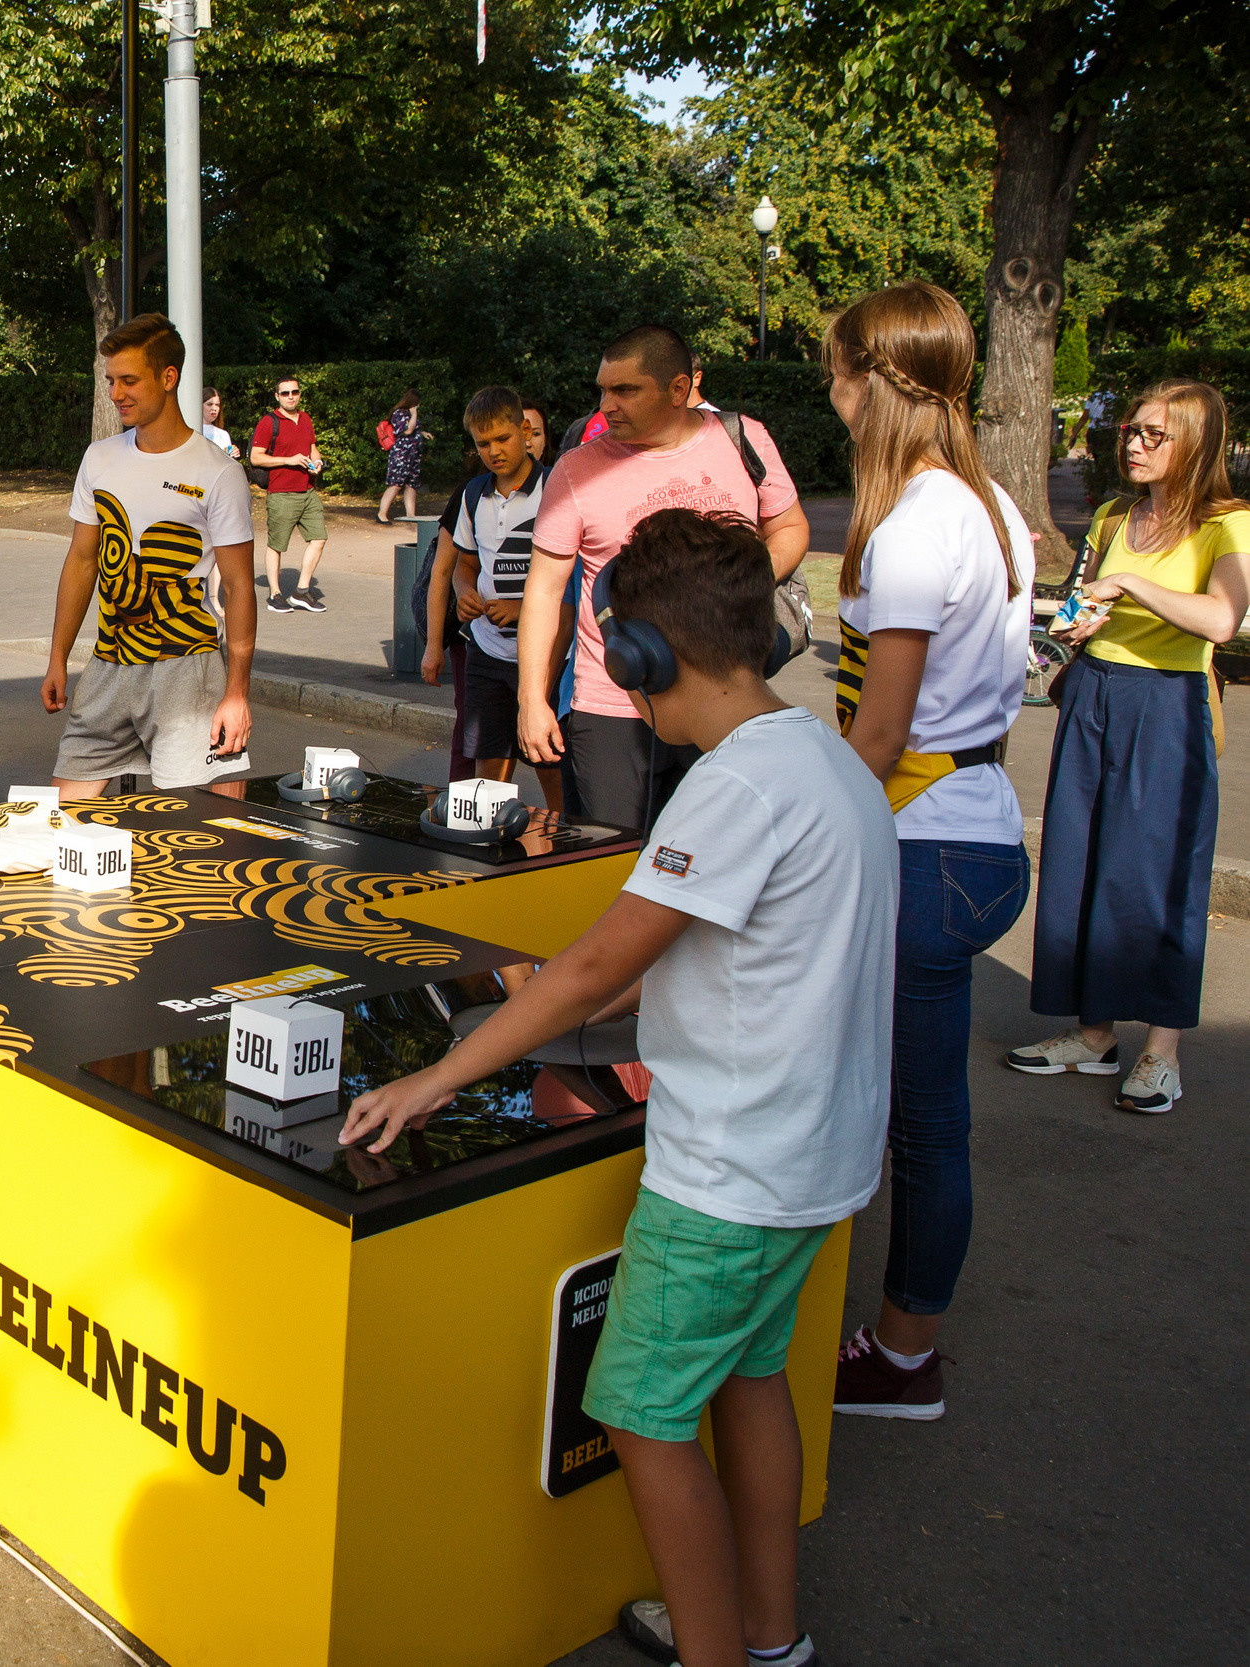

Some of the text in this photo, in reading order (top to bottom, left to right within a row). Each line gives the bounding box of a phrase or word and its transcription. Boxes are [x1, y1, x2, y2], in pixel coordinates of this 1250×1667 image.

[162, 481, 204, 498] Beelineup
[646, 490, 667, 502] ECO
[496, 561, 525, 571] ARMANI
[453, 797, 482, 823] JBL
[59, 846, 88, 876] JBL
[97, 849, 127, 876] JBL
[157, 967, 336, 1013] Beelineup
[236, 1027, 279, 1076] JBL
[293, 1037, 335, 1077] JBL
[571, 1301, 607, 1328] MELO
